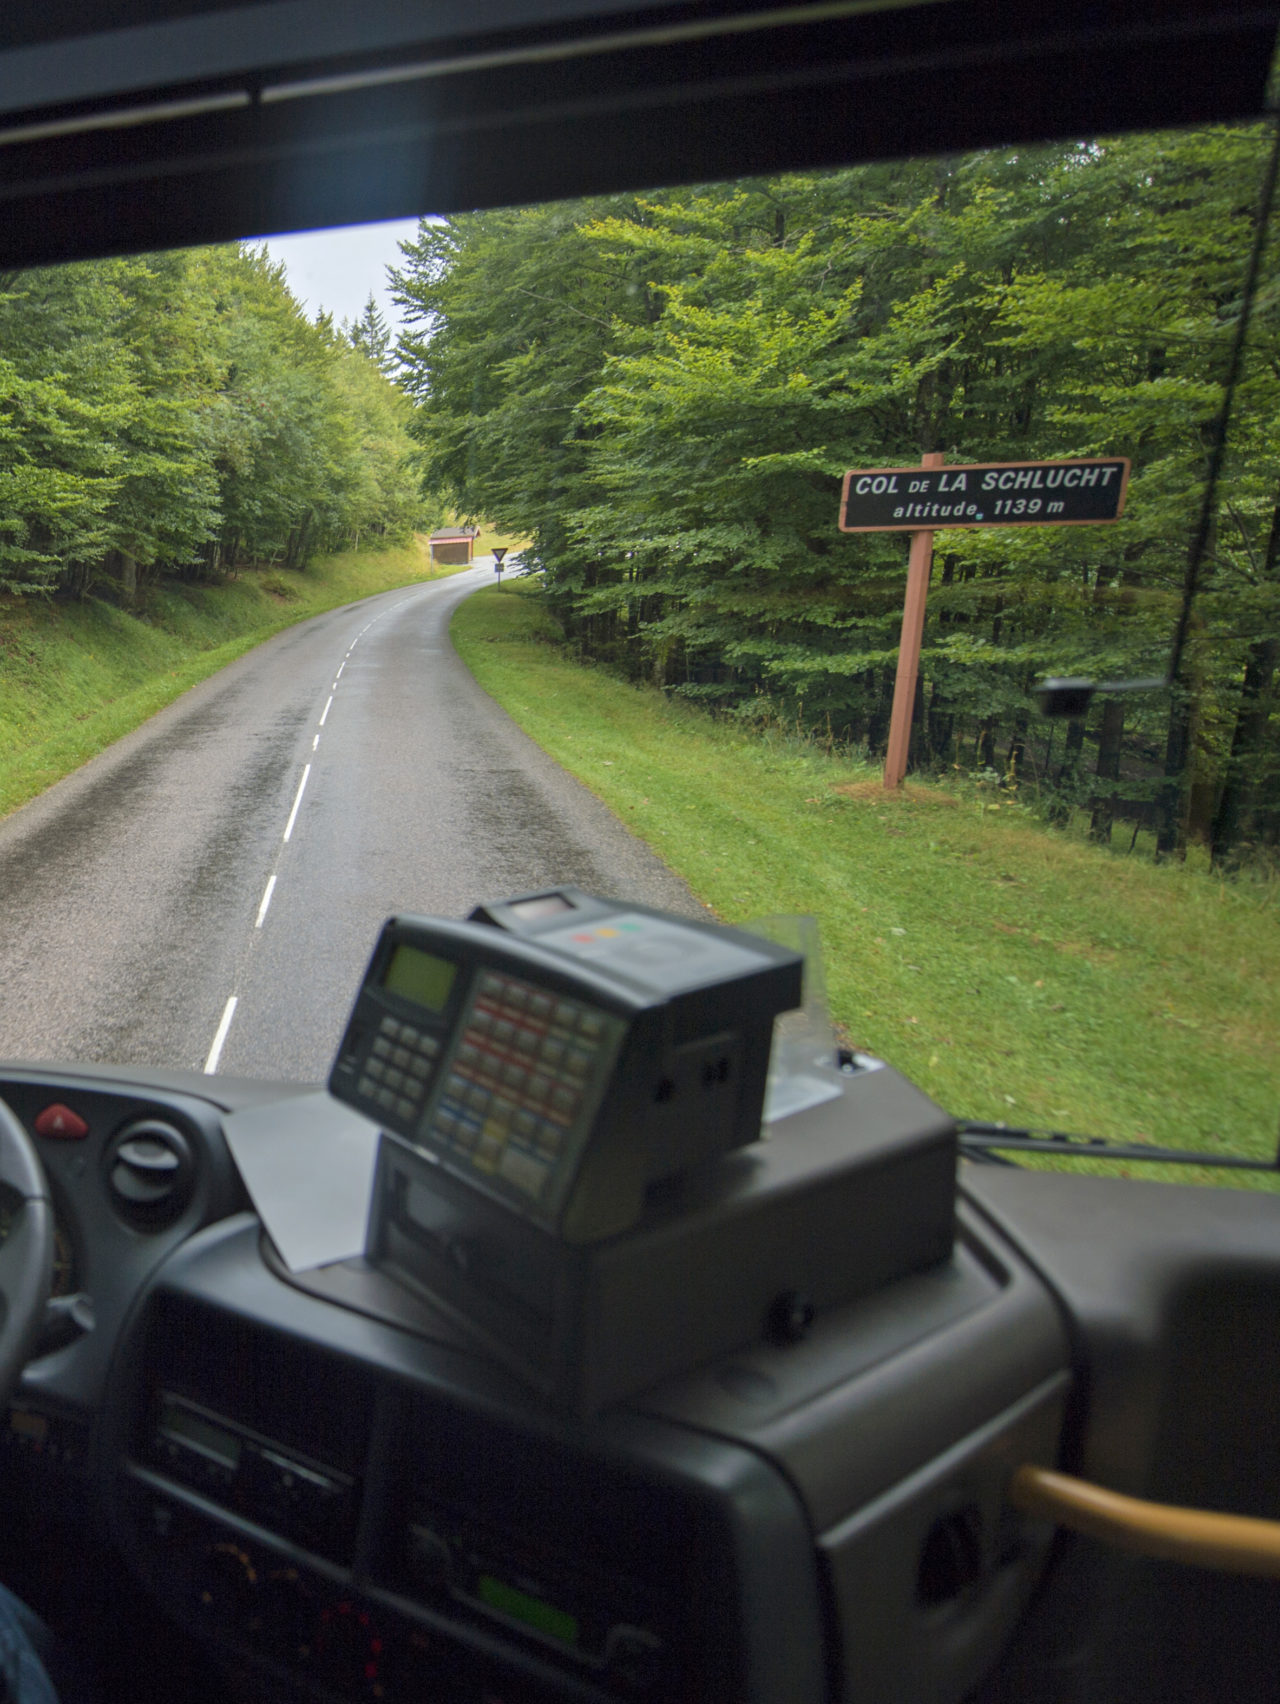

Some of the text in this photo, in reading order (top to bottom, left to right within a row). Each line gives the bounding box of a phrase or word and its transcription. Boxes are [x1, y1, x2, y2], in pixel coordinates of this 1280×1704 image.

[855, 467, 1118, 495] COL DE LA SCHLUCHT
[994, 499, 1042, 515] 1139
[1046, 501, 1065, 513] m
